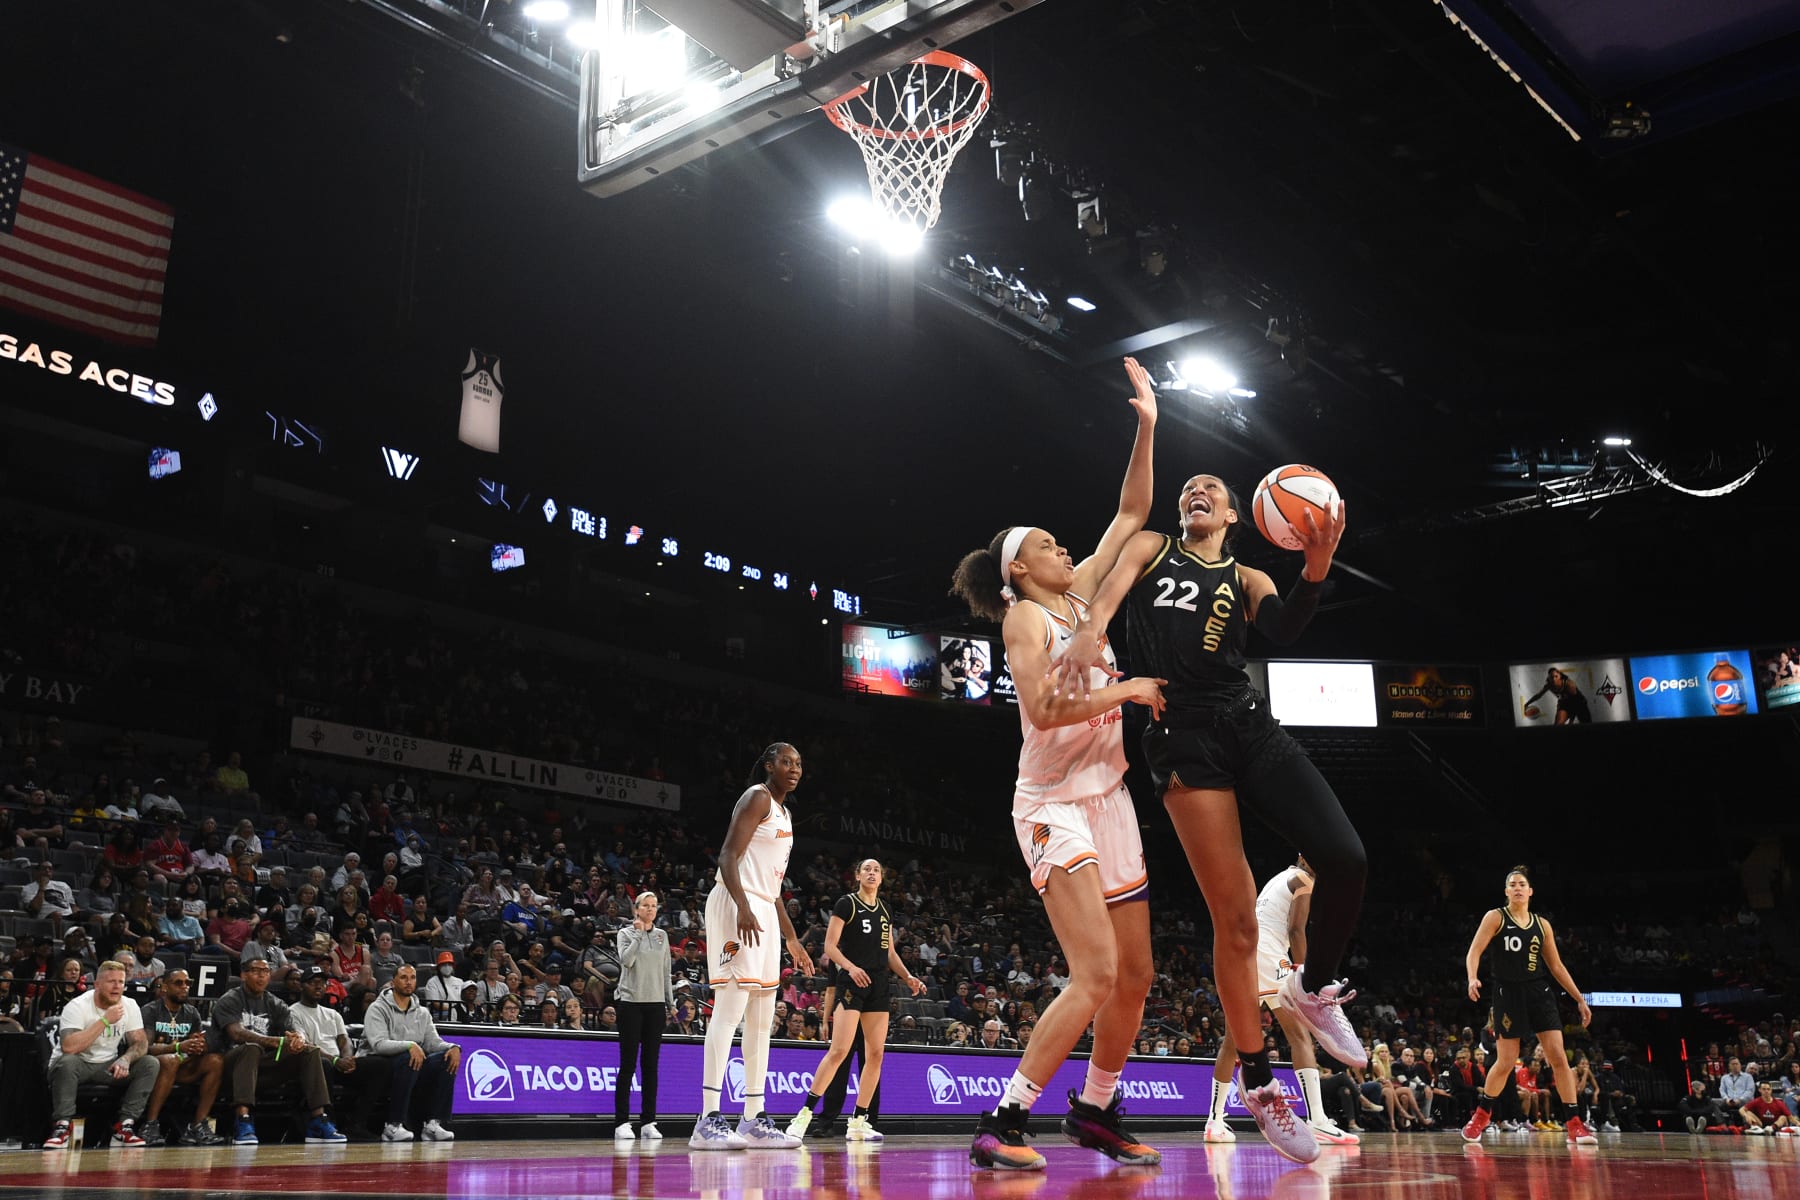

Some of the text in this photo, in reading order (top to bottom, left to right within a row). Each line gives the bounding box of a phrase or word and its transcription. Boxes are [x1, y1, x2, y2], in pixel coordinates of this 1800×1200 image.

[79, 361, 176, 406] ACES
[479, 372, 488, 386] 25
[571, 507, 607, 529] TOL: 3
[571, 519, 607, 539] FLS: 5
[662, 538, 678, 556] 36
[704, 552, 731, 572] 2:09
[742, 565, 761, 580] 2ND
[773, 573, 788, 589] 34
[1153, 577, 1200, 612] 22
[1203, 582, 1235, 652] ACES
[842, 643, 880, 661] LIGHT
[25, 675, 83, 704] BAY
[902, 677, 932, 689] LIGHT
[1660, 676, 1699, 693] pepsi
[448, 747, 558, 786] #ALLIN
[840, 815, 967, 853] MANDALAY BAY
[862, 919, 872, 934] 5
[880, 915, 889, 949] ACES
[1503, 935, 1522, 952] 10
[1527, 935, 1541, 972] ACES
[197, 965, 217, 997] F
[1599, 995, 1670, 1005] ULTRA ARENA
[515, 1065, 583, 1092] TACO
[766, 1071, 814, 1094] TACO
[957, 1075, 1002, 1097] TACO
[1149, 1081, 1184, 1100] BELL
